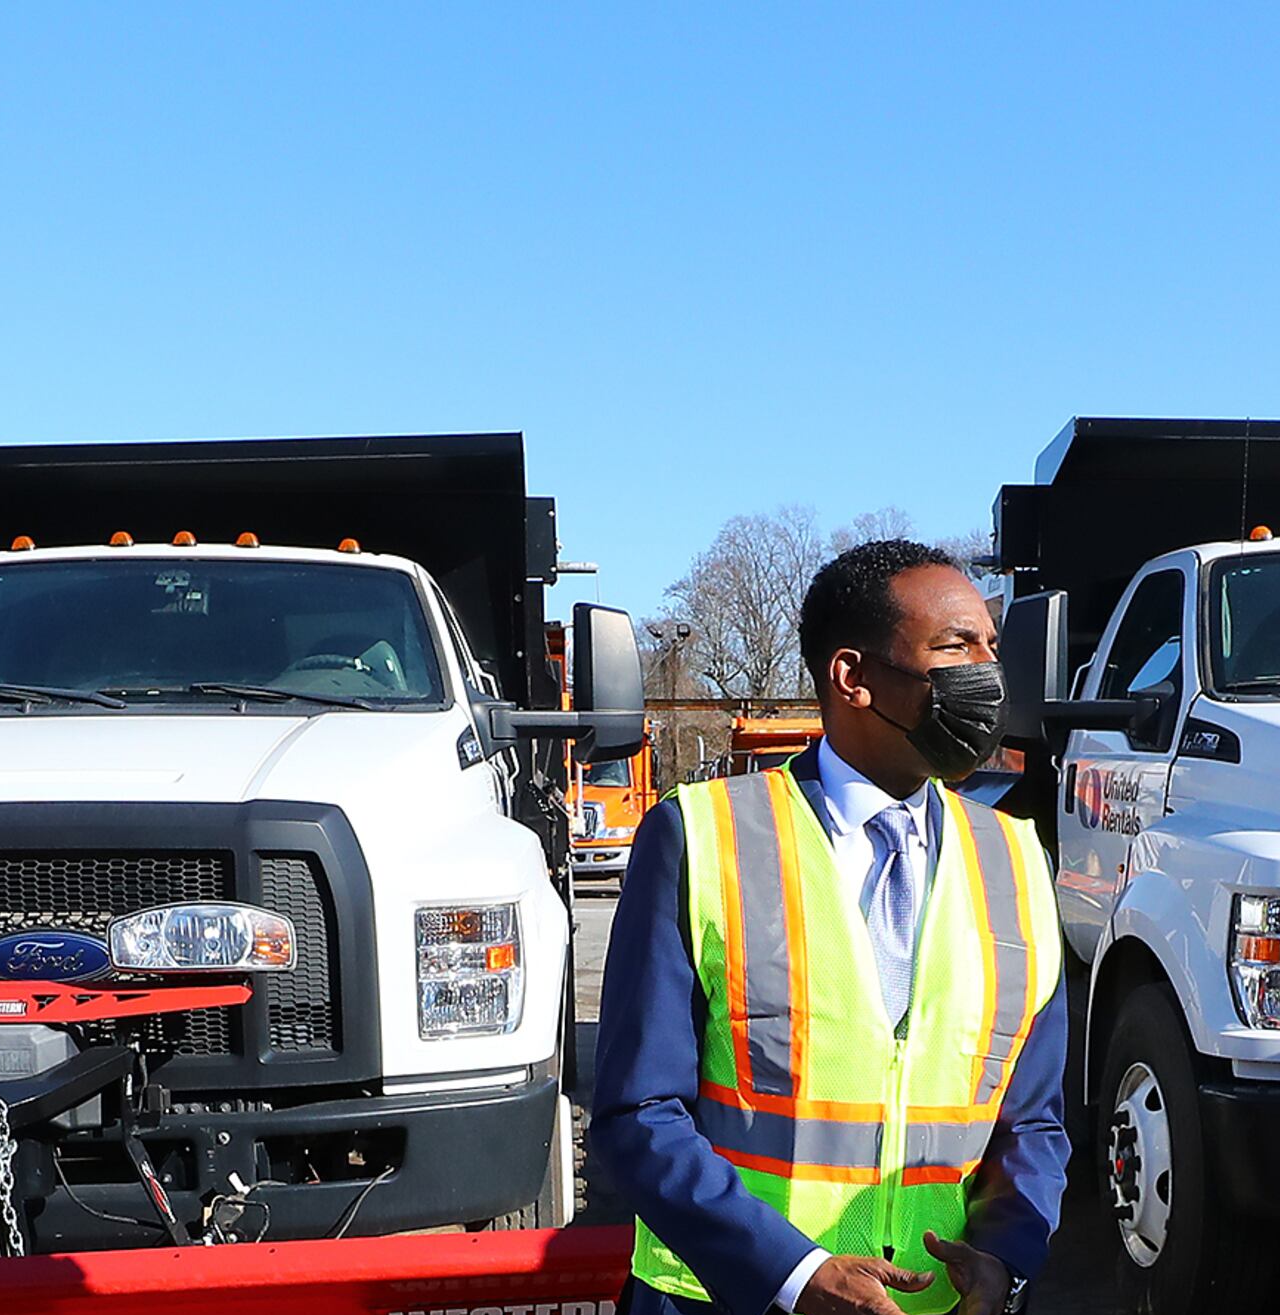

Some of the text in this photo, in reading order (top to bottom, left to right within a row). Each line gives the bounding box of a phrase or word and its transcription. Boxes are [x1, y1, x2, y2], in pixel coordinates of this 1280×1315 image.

[1103, 771, 1140, 802] United
[1102, 803, 1141, 836] Rentals
[7, 942, 84, 973] Ford
